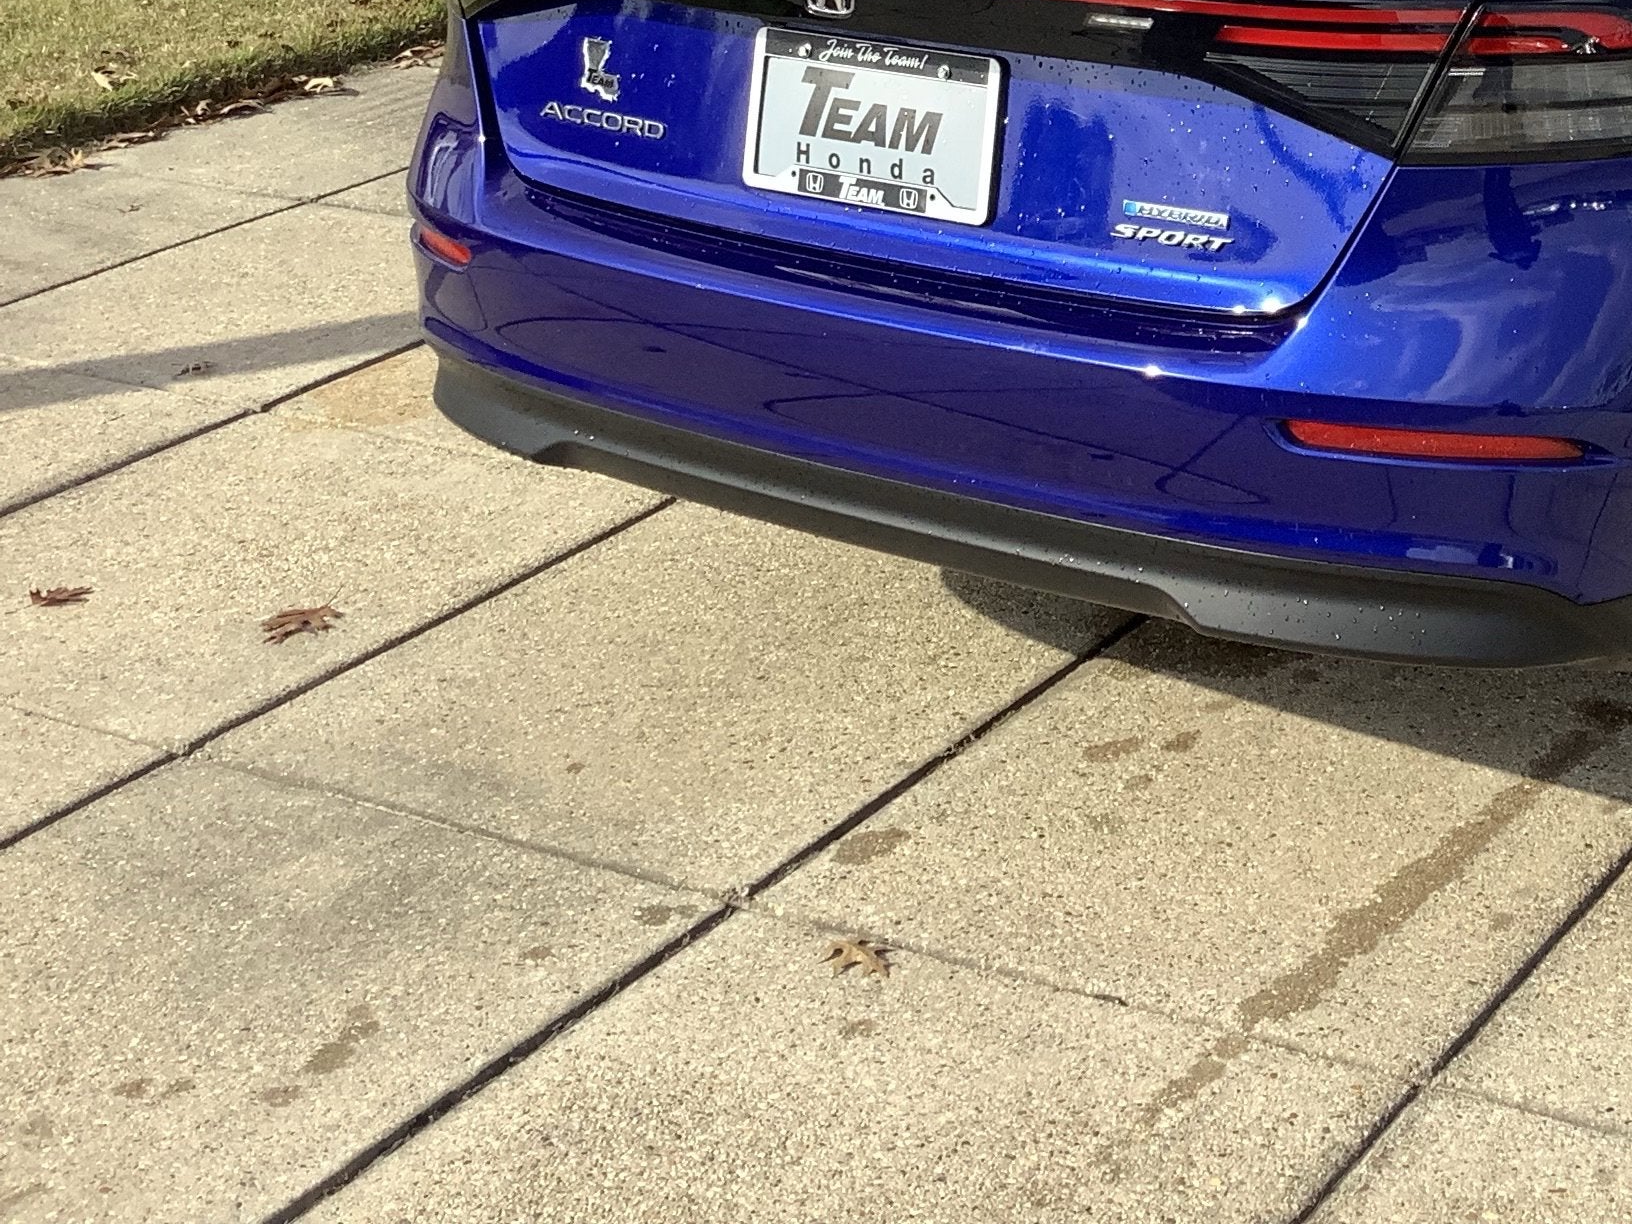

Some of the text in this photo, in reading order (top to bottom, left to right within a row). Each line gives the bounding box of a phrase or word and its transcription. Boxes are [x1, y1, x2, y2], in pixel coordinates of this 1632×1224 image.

[819, 39, 929, 70] Join The Team!
[540, 101, 667, 139] ACCORD
[795, 141, 936, 185] Honda
[1110, 223, 1236, 253] SPORT
